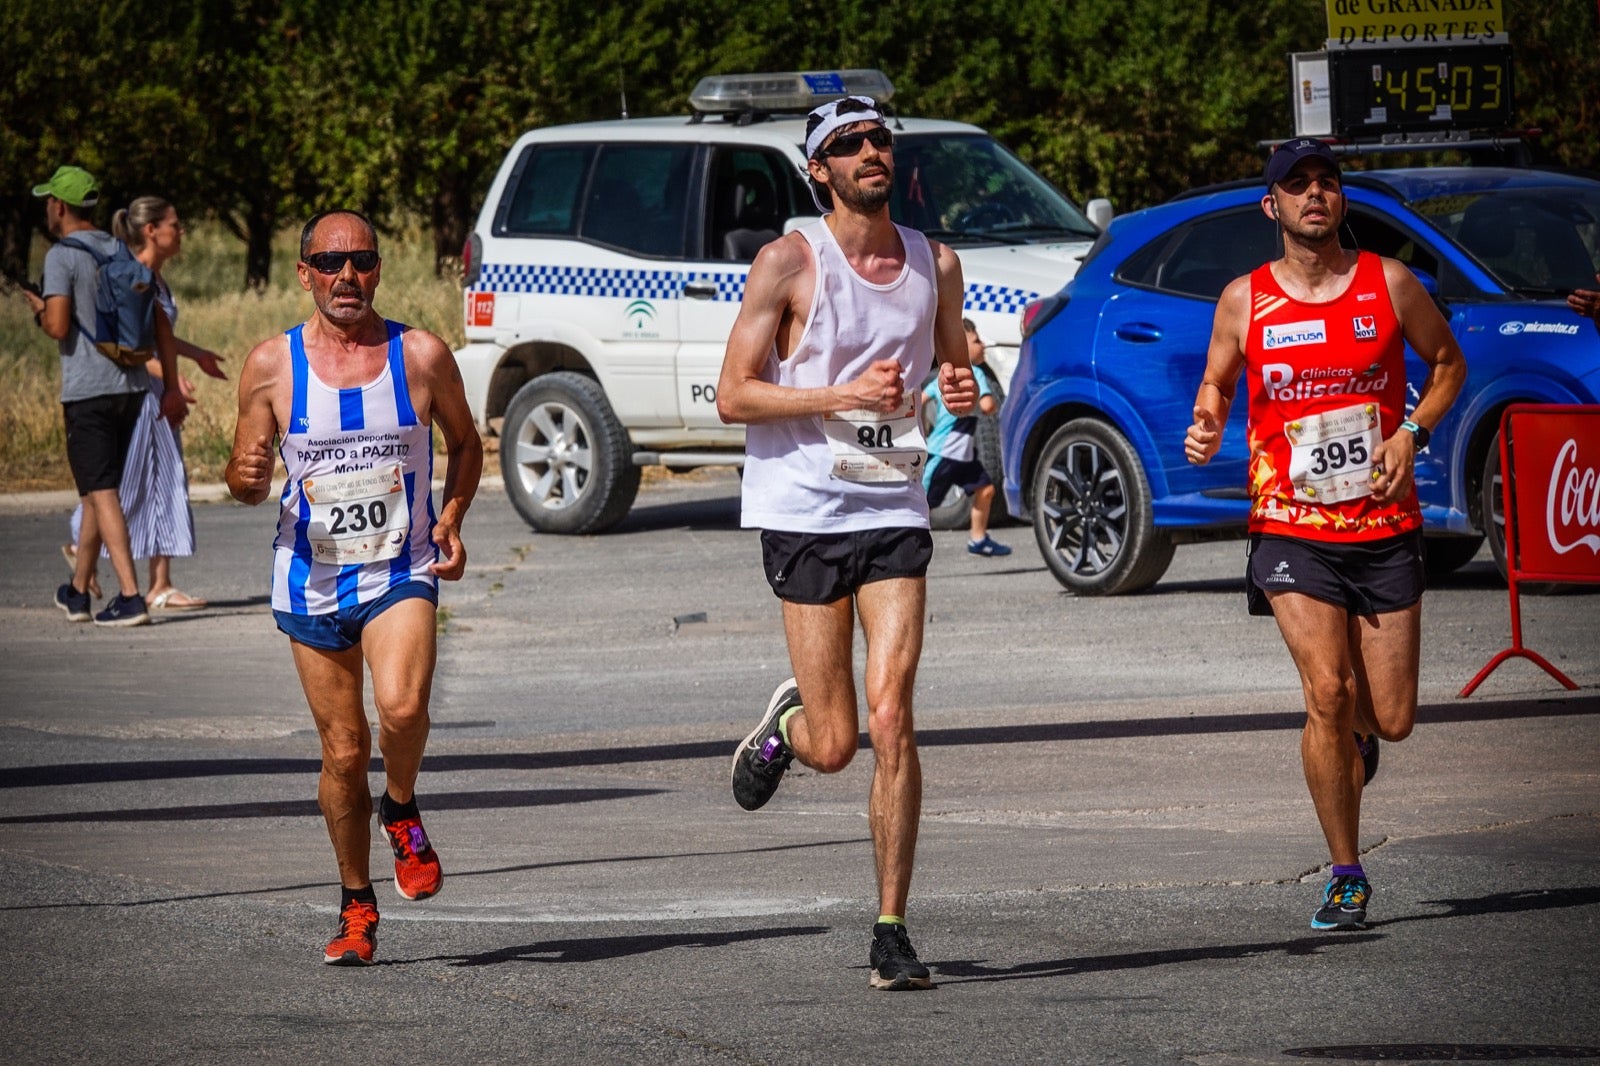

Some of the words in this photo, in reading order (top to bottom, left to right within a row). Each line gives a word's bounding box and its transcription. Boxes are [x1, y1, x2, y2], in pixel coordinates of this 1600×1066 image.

[1335, 0, 1361, 15] de
[1369, 0, 1494, 14] GRANADA
[1339, 20, 1496, 45] DEPORTES
[477, 301, 492, 314] 112
[1354, 329, 1376, 338] MOVE
[1523, 321, 1580, 335] micamotor.es
[1300, 367, 1353, 379] Clínicas
[1262, 363, 1388, 401] Polisalud
[308, 435, 355, 447] Asociación
[357, 433, 400, 443] Deportiva
[857, 424, 894, 448] 80
[297, 448, 345, 462] PAZITO
[350, 450, 358, 459] a
[362, 444, 410, 458] PAZITO
[1310, 436, 1368, 475] 395
[328, 500, 387, 535] 230
